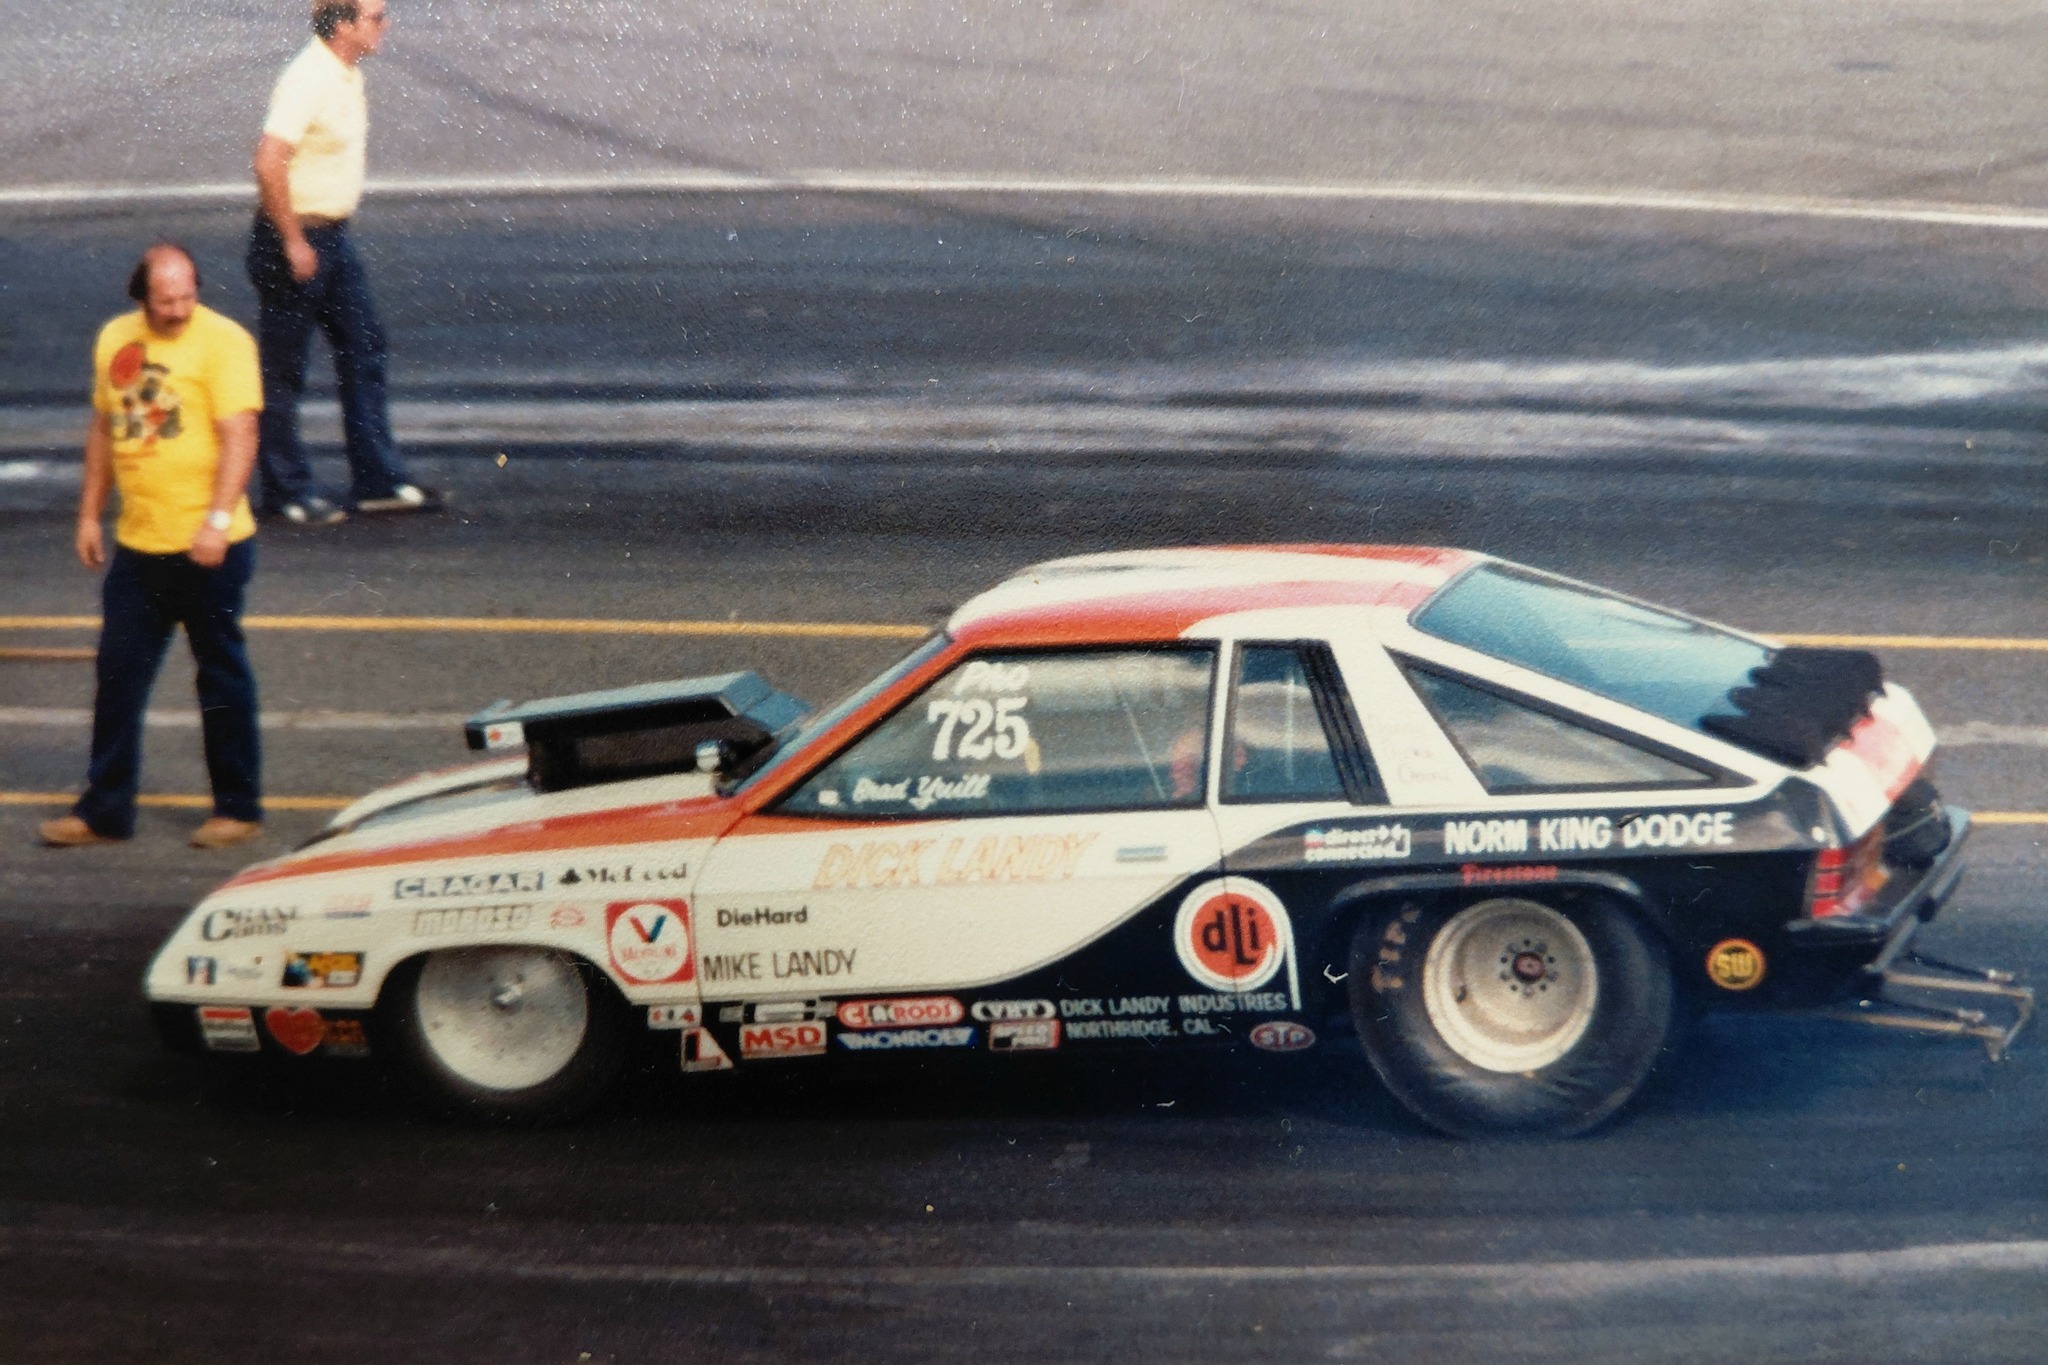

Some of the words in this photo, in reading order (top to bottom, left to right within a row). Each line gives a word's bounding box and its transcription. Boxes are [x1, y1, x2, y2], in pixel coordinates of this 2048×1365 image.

[928, 697, 1030, 761] 725
[1444, 818, 1528, 855] NORM
[1539, 816, 1612, 851] KING
[1618, 811, 1734, 848] DODGE
[812, 838, 937, 890] DICK
[934, 830, 1102, 886] LANDY
[717, 905, 808, 928] DieHard
[703, 952, 762, 982] MIKE
[772, 948, 858, 979] LANDY
[1060, 998, 1105, 1017] DICK
[1108, 996, 1170, 1016] LANDY
[1178, 992, 1287, 1013] INDUSTRIES
[743, 1025, 822, 1050] MSD
